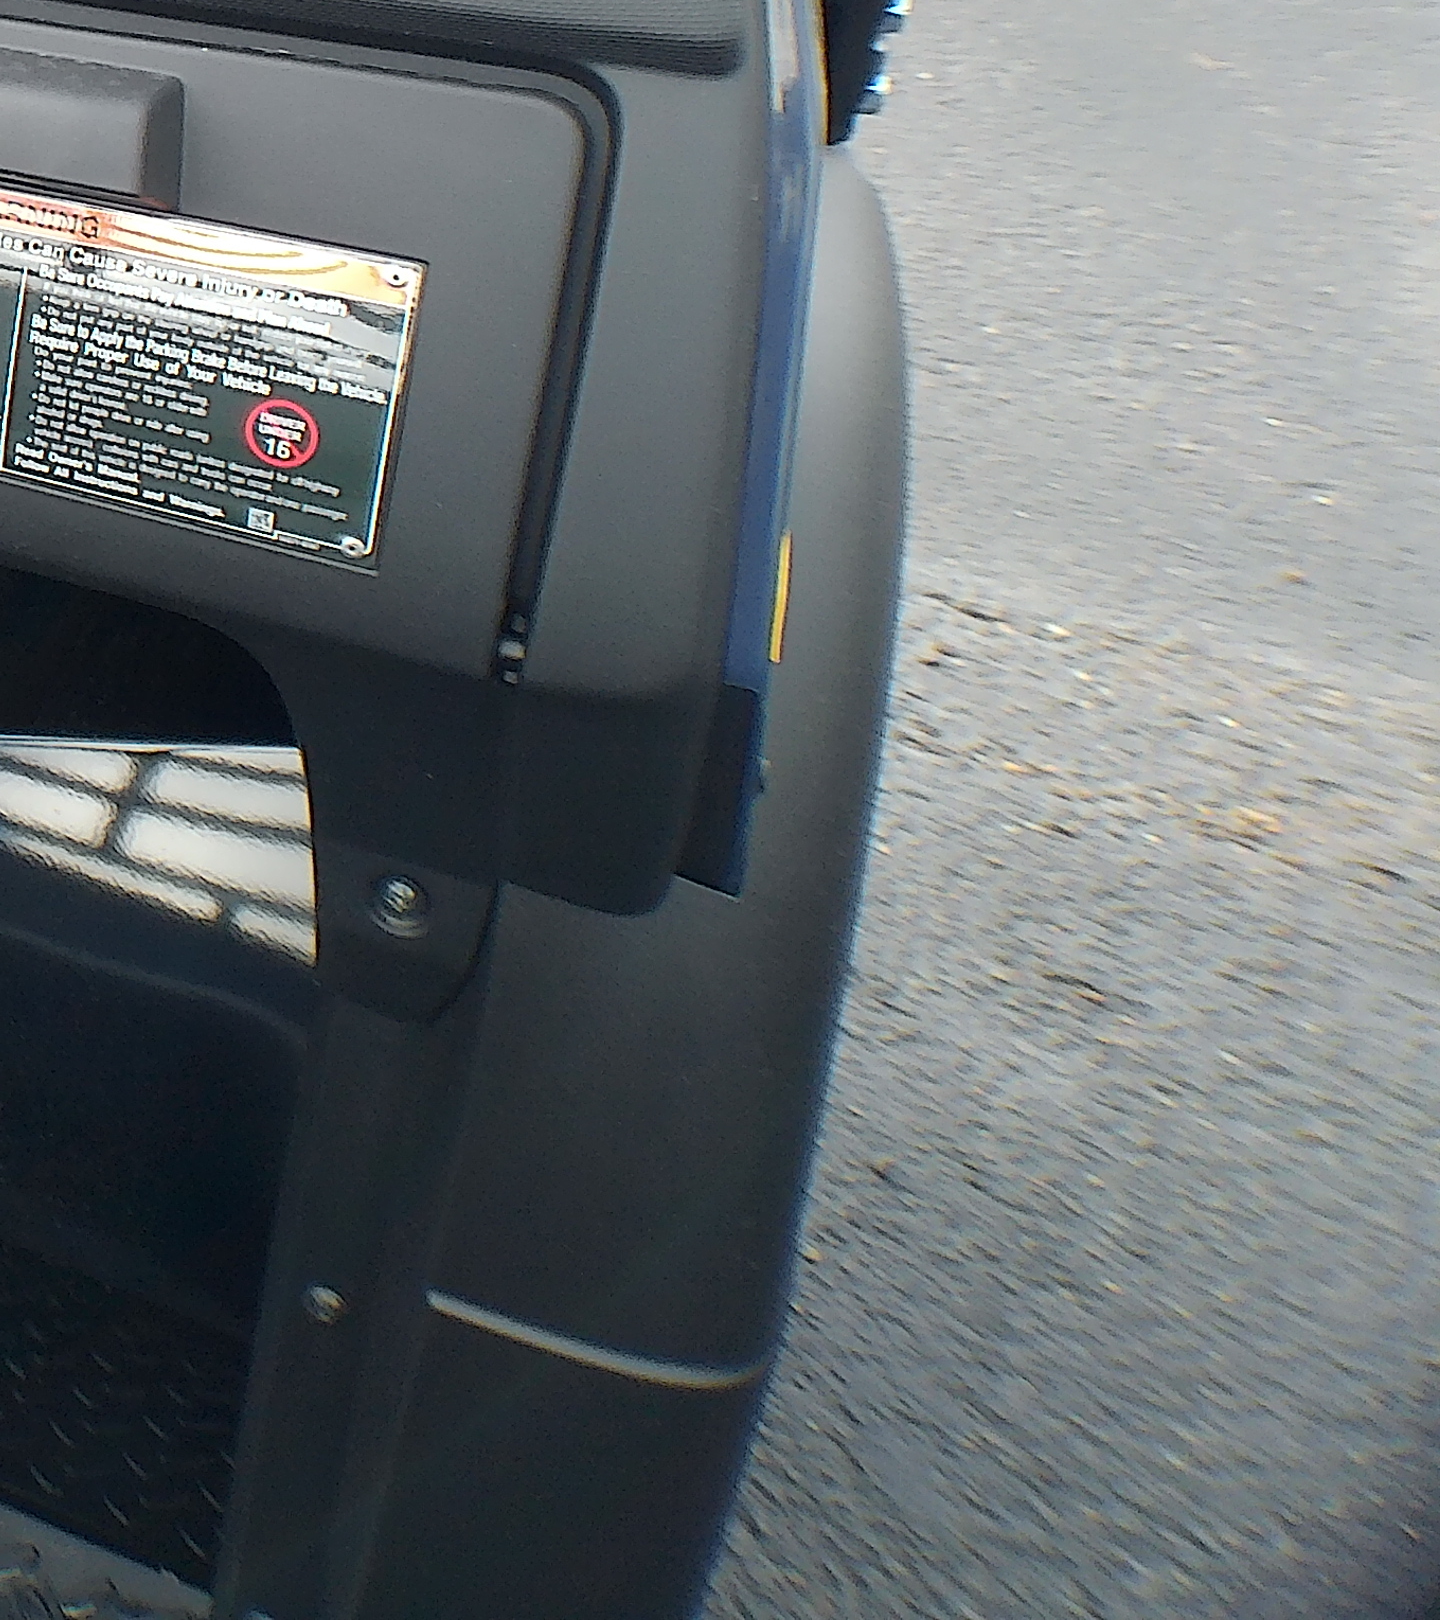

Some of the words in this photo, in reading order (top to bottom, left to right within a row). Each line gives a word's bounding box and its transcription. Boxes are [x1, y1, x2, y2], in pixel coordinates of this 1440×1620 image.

[28, 237, 64, 259] Can
[69, 245, 128, 272] Cause
[131, 257, 200, 286] Severe
[201, 271, 259, 302] Injury
[264, 287, 284, 303] or
[287, 289, 349, 317] Death
[38, 263, 55, 280] Be
[56, 266, 85, 286] Sure
[85, 272, 150, 302] Occupants
[28, 330, 79, 356] Require
[83, 343, 129, 367] Proper
[133, 353, 160, 371] Use
[164, 360, 180, 375] of
[185, 365, 217, 384] Your
[221, 373, 271, 396] Vehicle
[31, 314, 48, 330] Be
[48, 318, 75, 336] Sure
[76, 324, 90, 339] to
[89, 327, 124, 349] Apply
[124, 335, 144, 351] the
[144, 339, 190, 364] Parking
[190, 349, 227, 369] Brake
[226, 357, 268, 378] Before
[267, 366, 317, 392] Leaving
[317, 377, 339, 394] the
[257, 422, 302, 442] UNDER
[259, 411, 306, 431] DRIVER
[15, 443, 44, 459] Read
[47, 451, 93, 472] Owner's
[97, 463, 141, 483] Manual.
[262, 436, 292, 460] 16
[14, 455, 50, 473] Follow
[53, 465, 70, 478] All
[73, 470, 139, 496] Instructions
[142, 487, 164, 502] and
[167, 493, 226, 520] Warnings.
